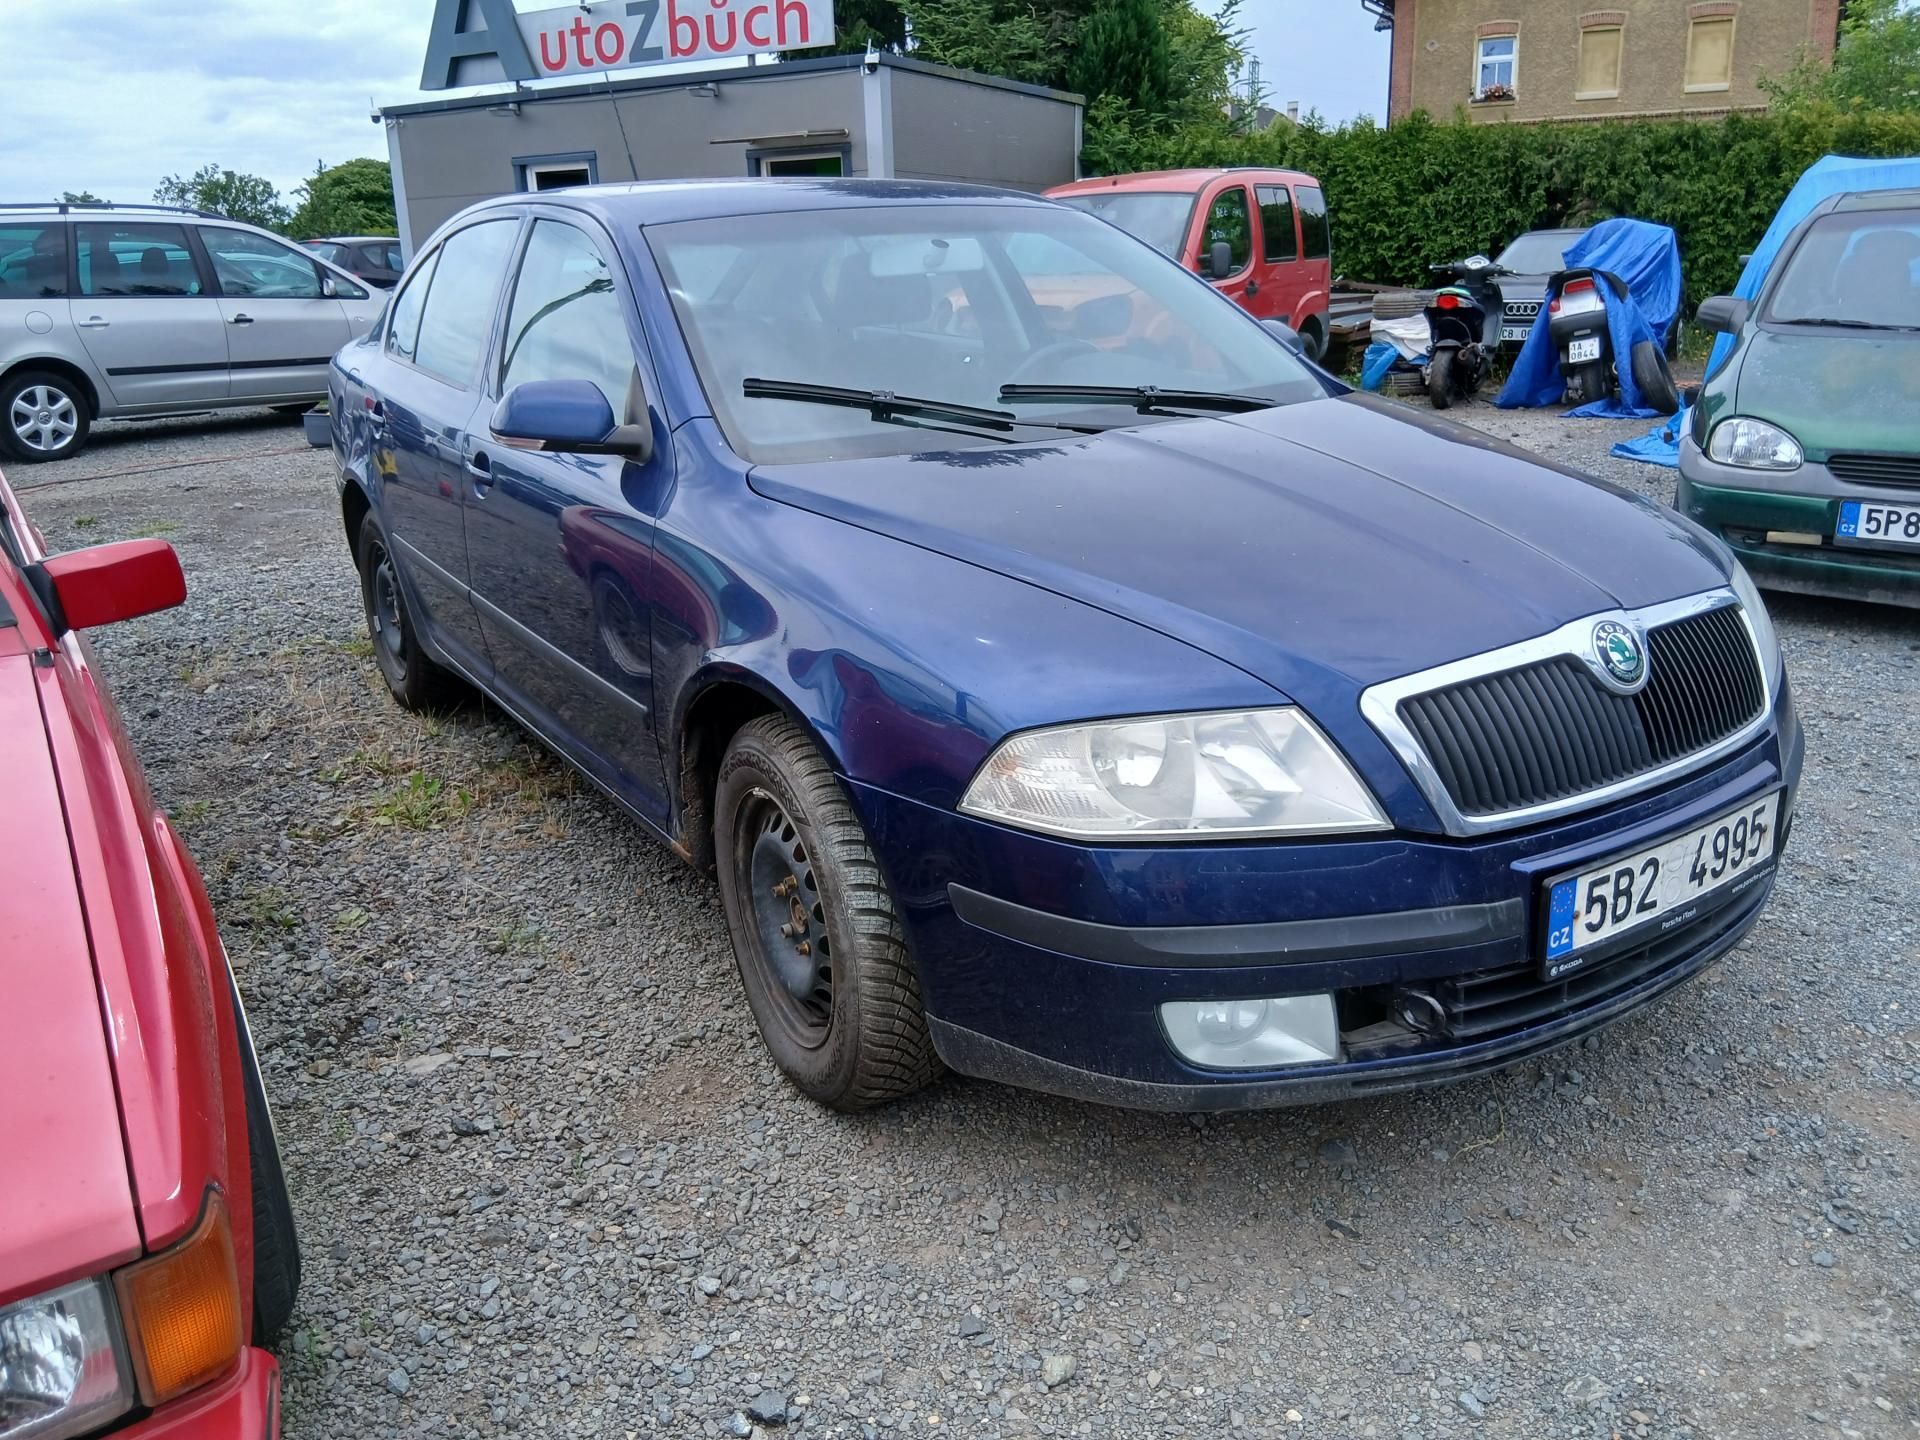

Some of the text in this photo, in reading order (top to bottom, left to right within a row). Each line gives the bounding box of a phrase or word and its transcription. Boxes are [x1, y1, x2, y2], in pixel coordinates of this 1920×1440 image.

[1572, 342, 1582, 351] 1A
[1841, 523, 1856, 533] CZ
[1865, 508, 1920, 538] 5P8
[1584, 804, 1767, 933] 5B2 4995
[1550, 926, 1570, 949] CZ
